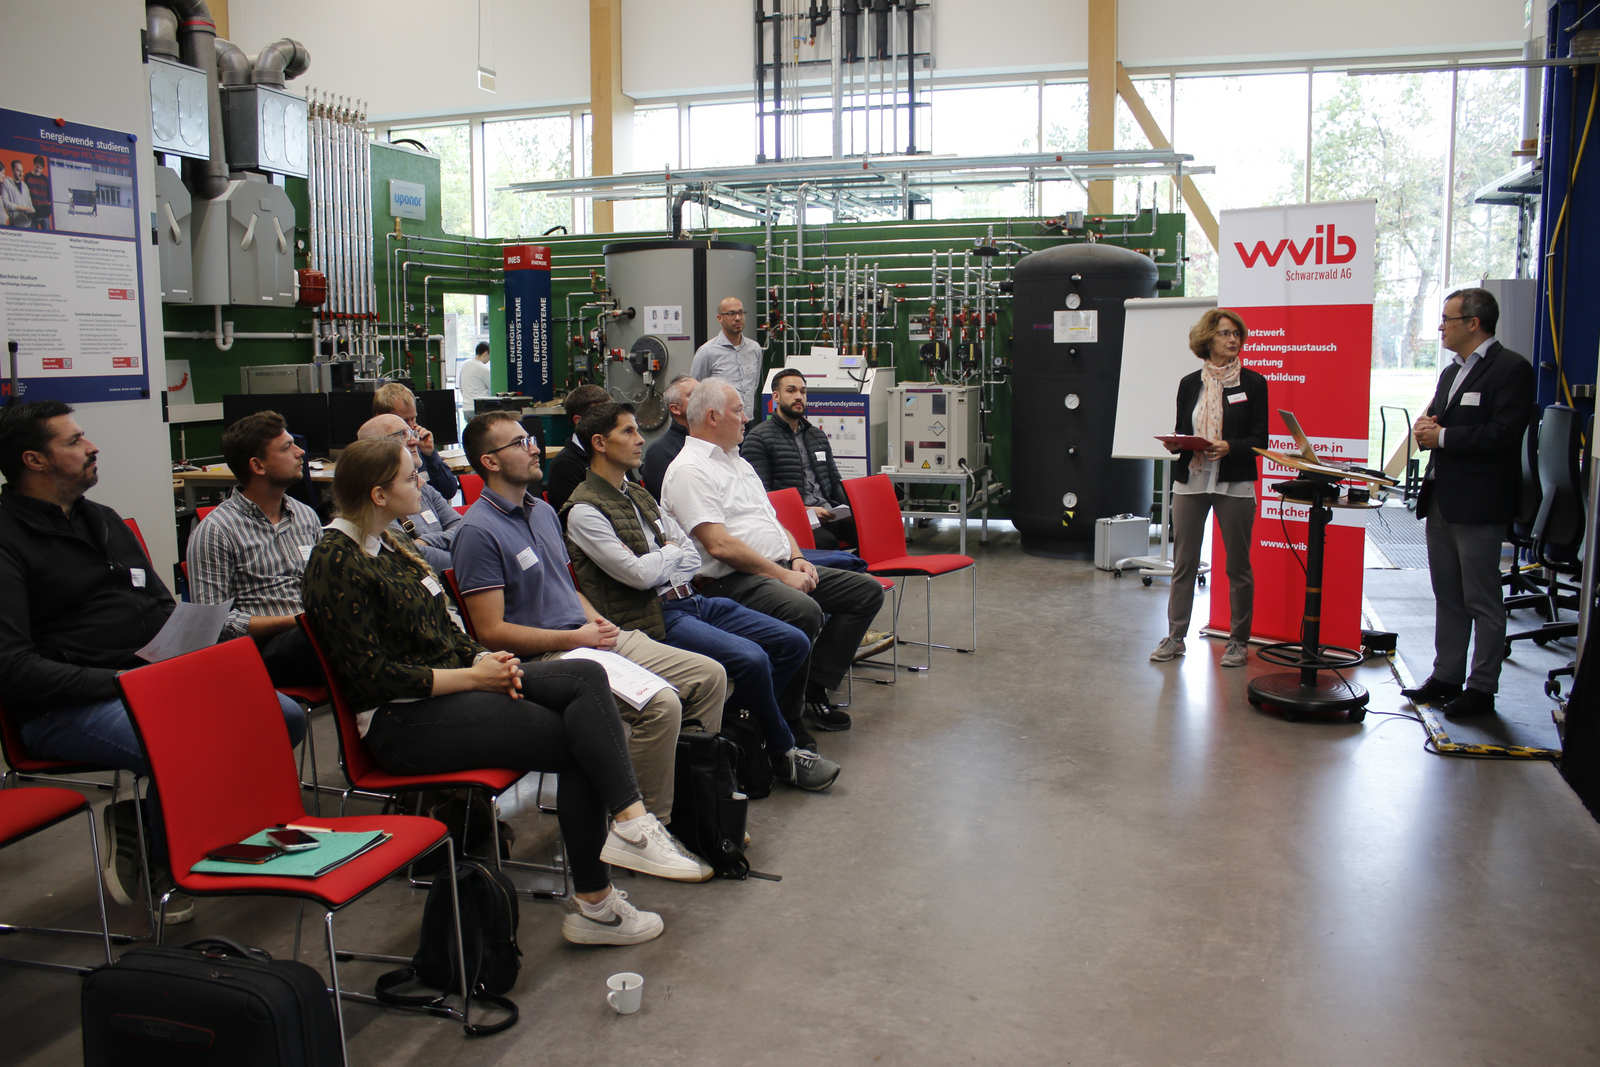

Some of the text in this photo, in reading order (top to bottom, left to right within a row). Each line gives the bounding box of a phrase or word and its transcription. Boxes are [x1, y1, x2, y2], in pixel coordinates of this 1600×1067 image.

[40, 129, 130, 154] Energiewende studieren
[394, 193, 422, 207] uponor
[1234, 224, 1357, 268] wvib
[507, 255, 521, 264] INES
[1286, 268, 1352, 281] Schwarzwald AG
[515, 297, 523, 386] VERBUNDSYSTEME
[540, 297, 548, 386] VERBUNDSYSTEME
[1243, 343, 1337, 353] Erfahrungsaustausch
[1243, 358, 1283, 368] Beratung
[1263, 373, 1305, 384] erbildung
[1269, 439, 1343, 452] Mensen in
